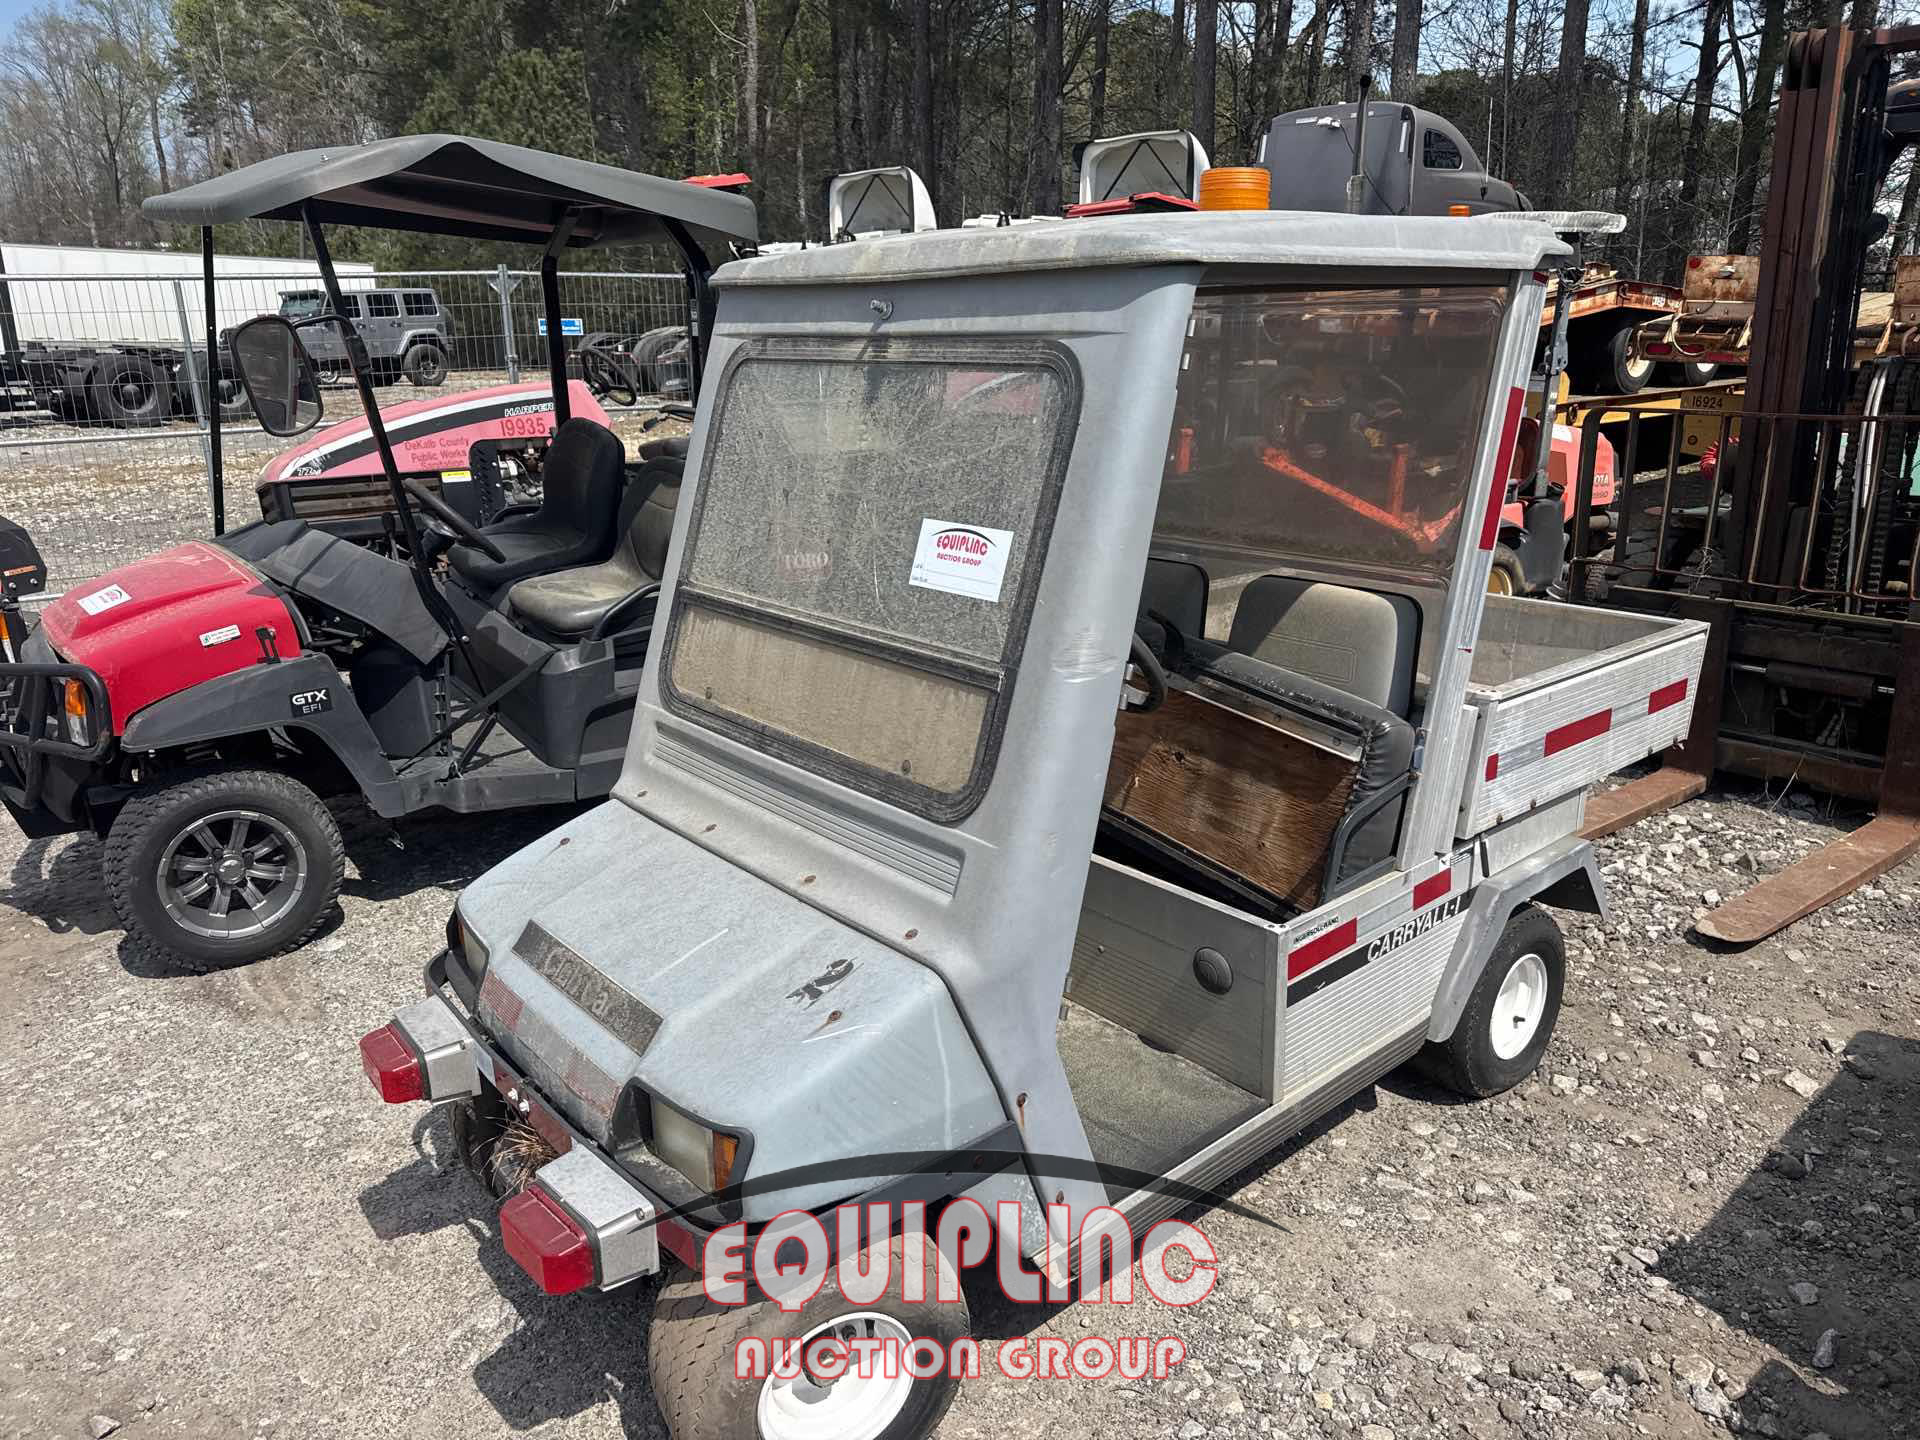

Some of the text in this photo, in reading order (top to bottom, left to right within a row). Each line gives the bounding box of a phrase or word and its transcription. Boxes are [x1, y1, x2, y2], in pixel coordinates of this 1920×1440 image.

[1692, 395, 1722, 409] 16924
[501, 417, 546, 437] 19935
[936, 534, 989, 556] EQUIPLINC
[292, 689, 327, 706] GTX
[303, 703, 322, 714] EFI
